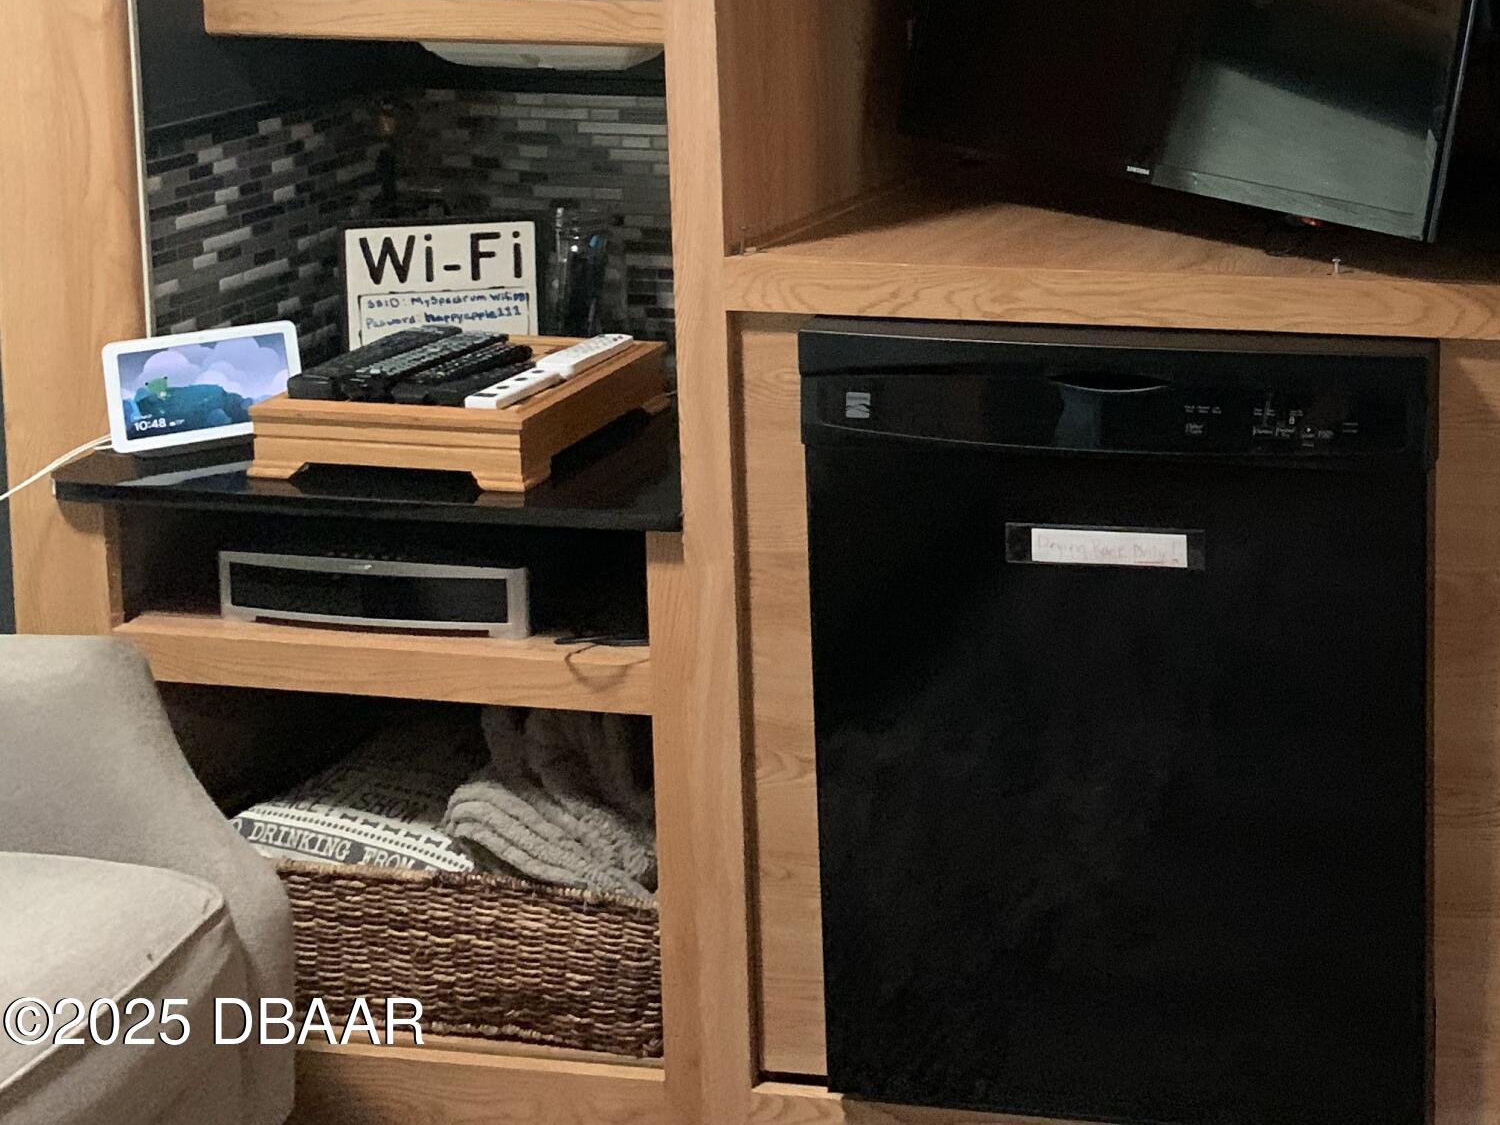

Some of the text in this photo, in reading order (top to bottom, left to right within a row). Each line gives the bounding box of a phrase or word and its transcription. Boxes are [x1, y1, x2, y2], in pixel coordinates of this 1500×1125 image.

[359, 231, 524, 285] Wi-Fi
[134, 417, 167, 432] 10:48
[247, 821, 351, 861] DRINKING
[357, 846, 416, 871] FROM
